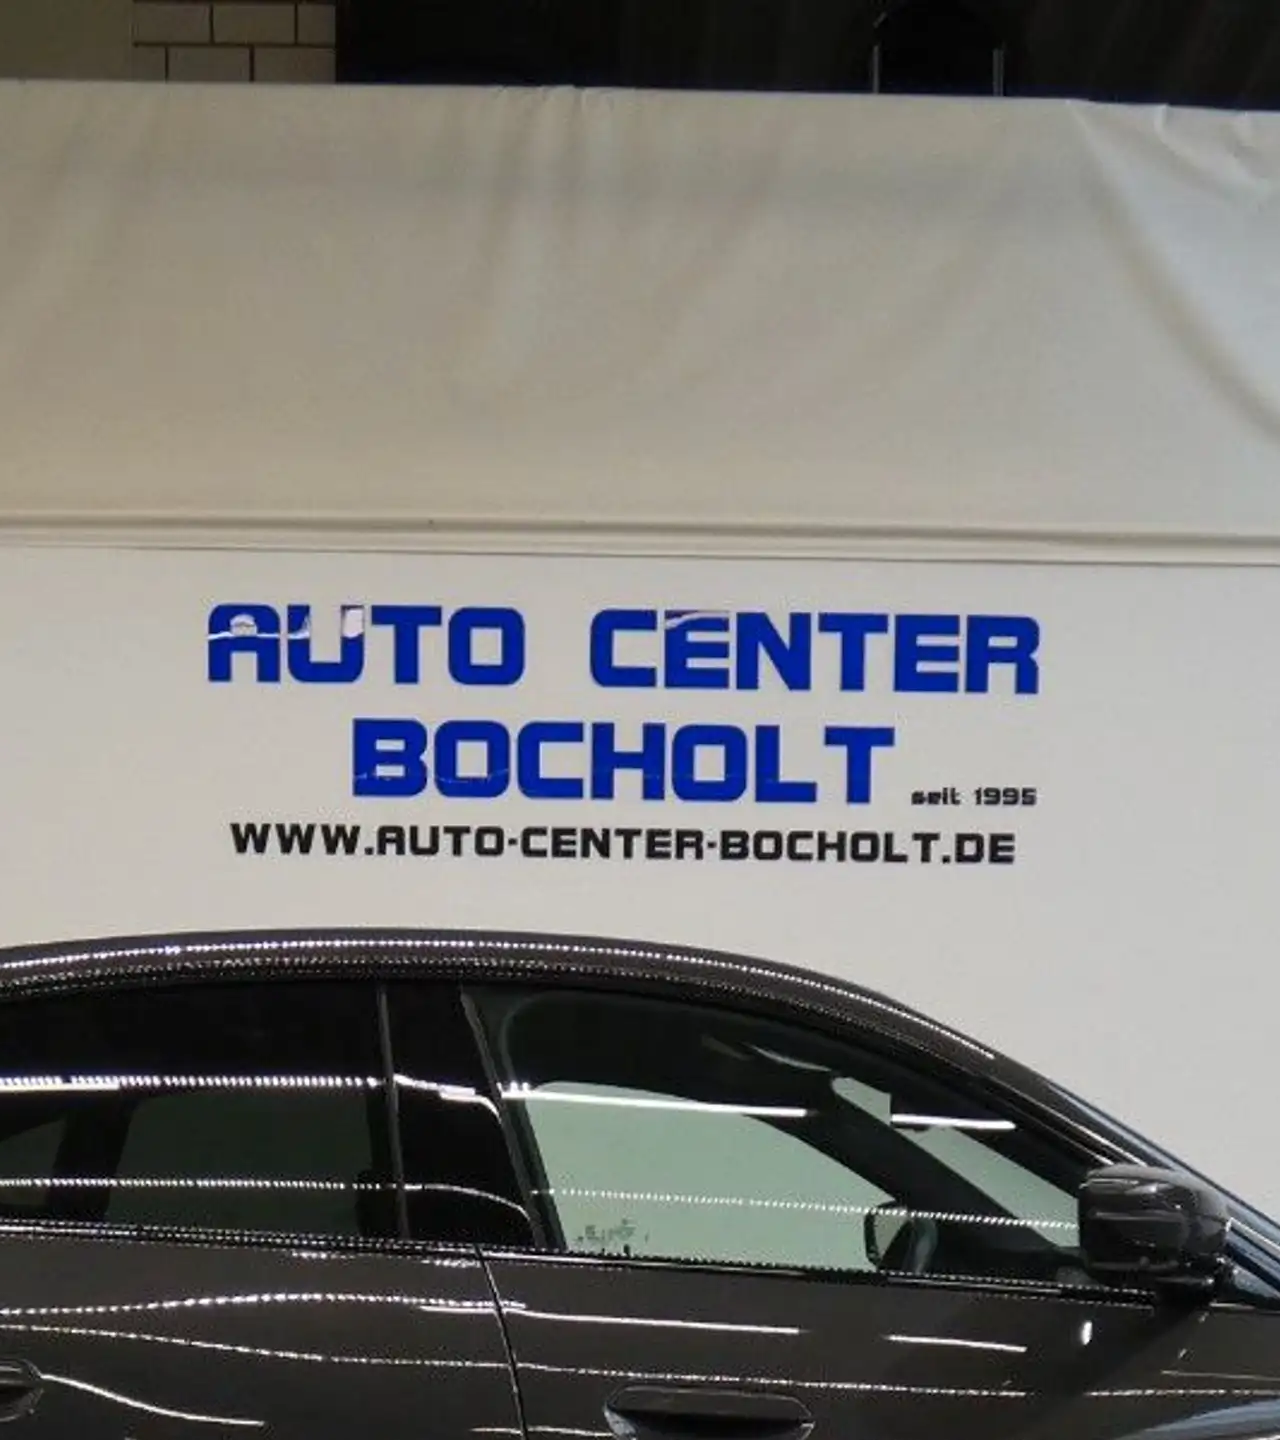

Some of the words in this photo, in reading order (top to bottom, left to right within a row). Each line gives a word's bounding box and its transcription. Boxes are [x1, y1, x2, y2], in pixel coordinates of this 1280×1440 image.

[207, 603, 526, 685] AUTO
[589, 608, 1040, 695] CENTER
[352, 717, 895, 805] BOCHOLT
[910, 786, 962, 806] seit
[974, 786, 1037, 806] 1995
[229, 822, 1015, 865] WWW.AUTO-CENTER-BOCHOLT.DE
